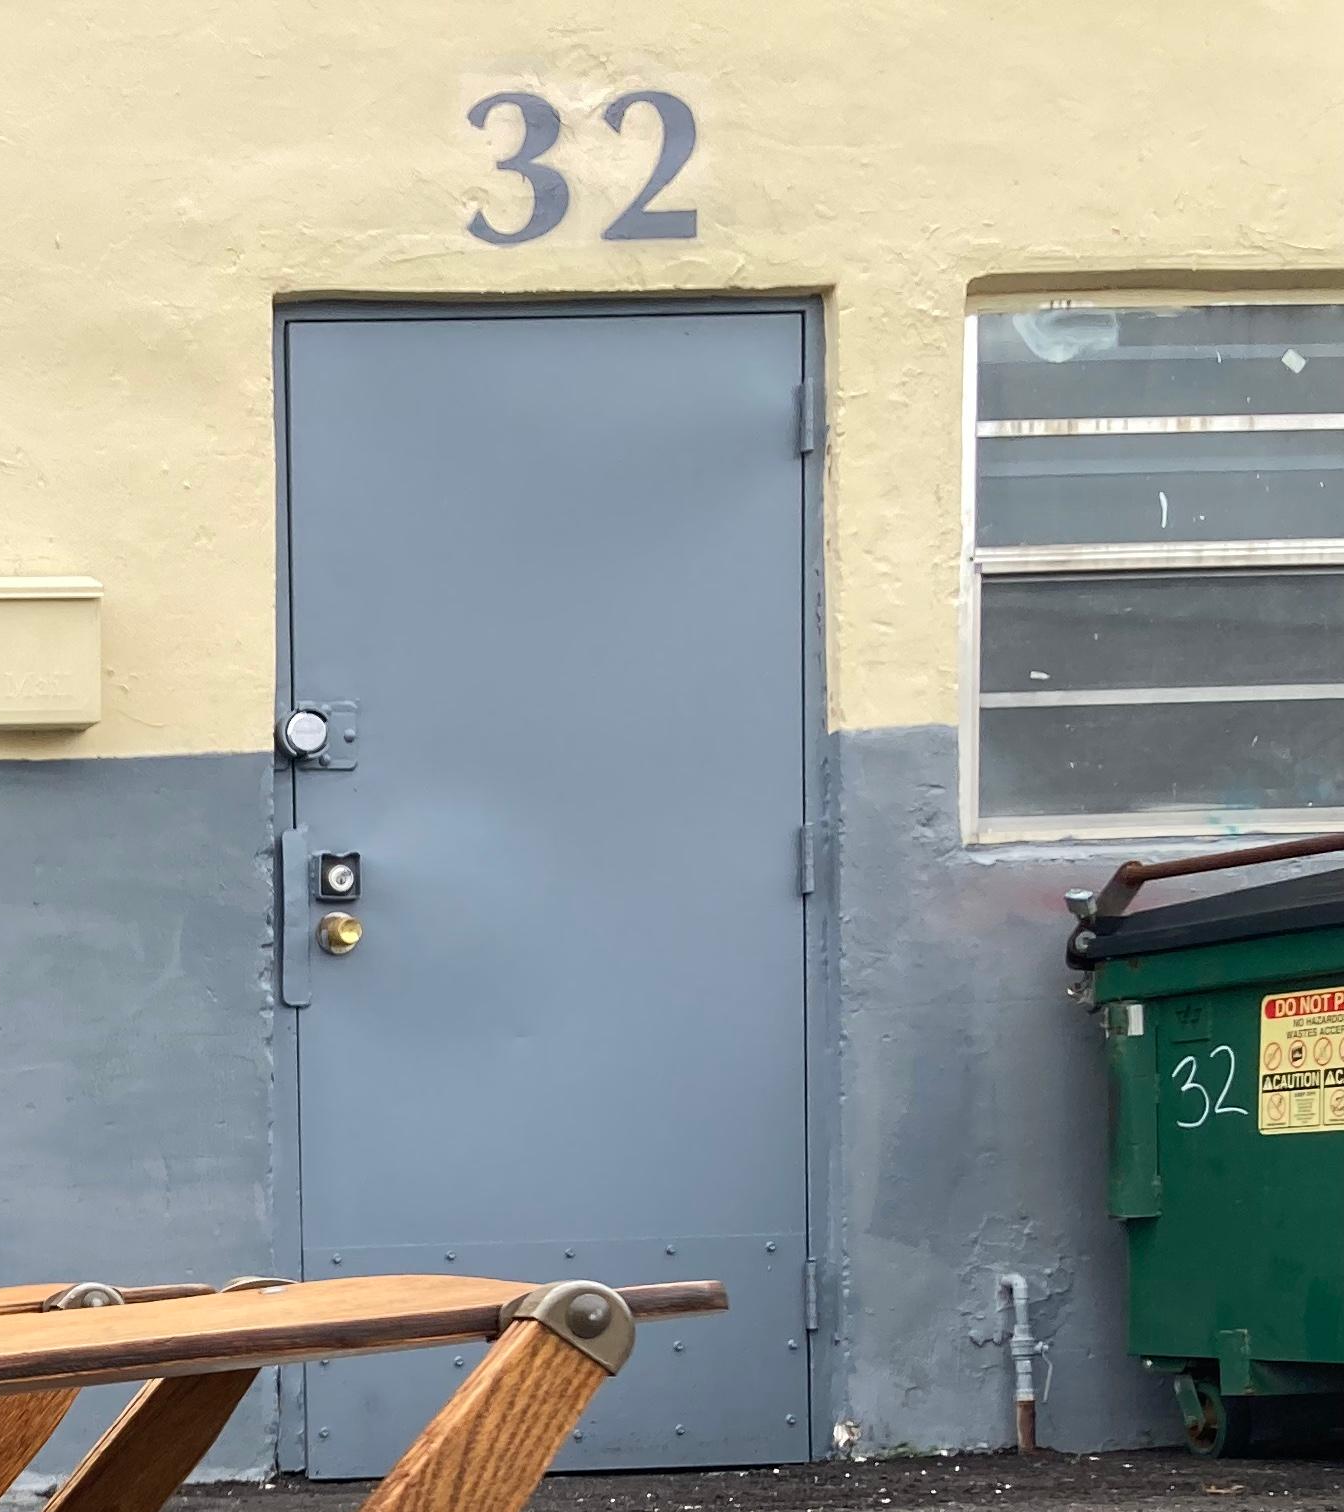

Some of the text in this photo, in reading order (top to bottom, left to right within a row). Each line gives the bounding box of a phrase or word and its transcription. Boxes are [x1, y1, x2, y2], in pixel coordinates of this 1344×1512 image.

[466, 90, 698, 245] 32
[1275, 998, 1297, 1017] DO
[1299, 993, 1332, 1015] NOT
[1171, 1045, 1249, 1128] 32
[1273, 1071, 1320, 1090] CAUTION
